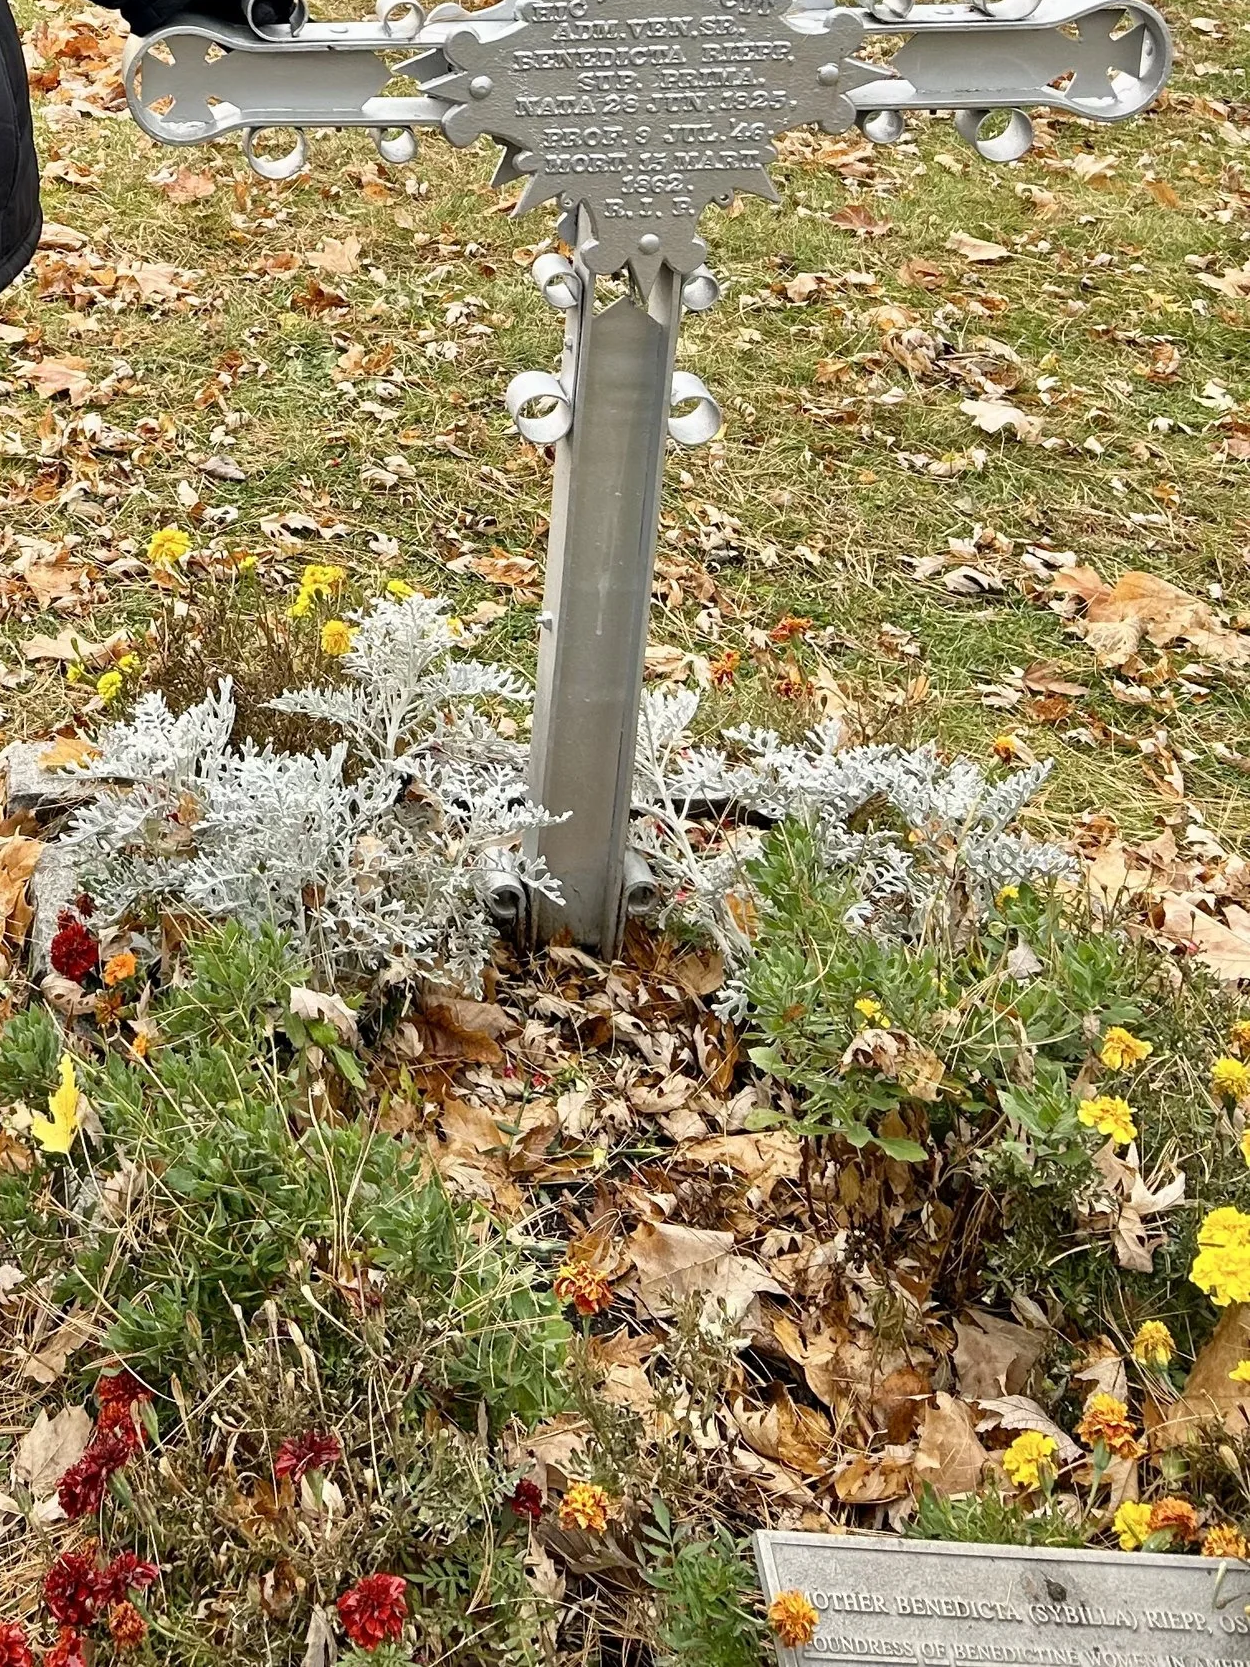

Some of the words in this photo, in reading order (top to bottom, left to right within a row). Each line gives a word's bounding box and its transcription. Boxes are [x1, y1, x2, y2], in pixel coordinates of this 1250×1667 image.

[512, 45, 686, 71] BENEDICTA
[514, 95, 596, 117] NATA
[543, 126, 628, 148] PROF.
[545, 153, 633, 174] MORT.
[895, 1596, 1022, 1621] BENEDICTA
[1028, 1603, 1138, 1631] (SYBILLA)
[1143, 1610, 1212, 1635] RIEPP,
[807, 1636, 917, 1657] OUNDRESS
[921, 1641, 945, 1659] OF
[952, 1644, 1080, 1666] BENEDICTINE
